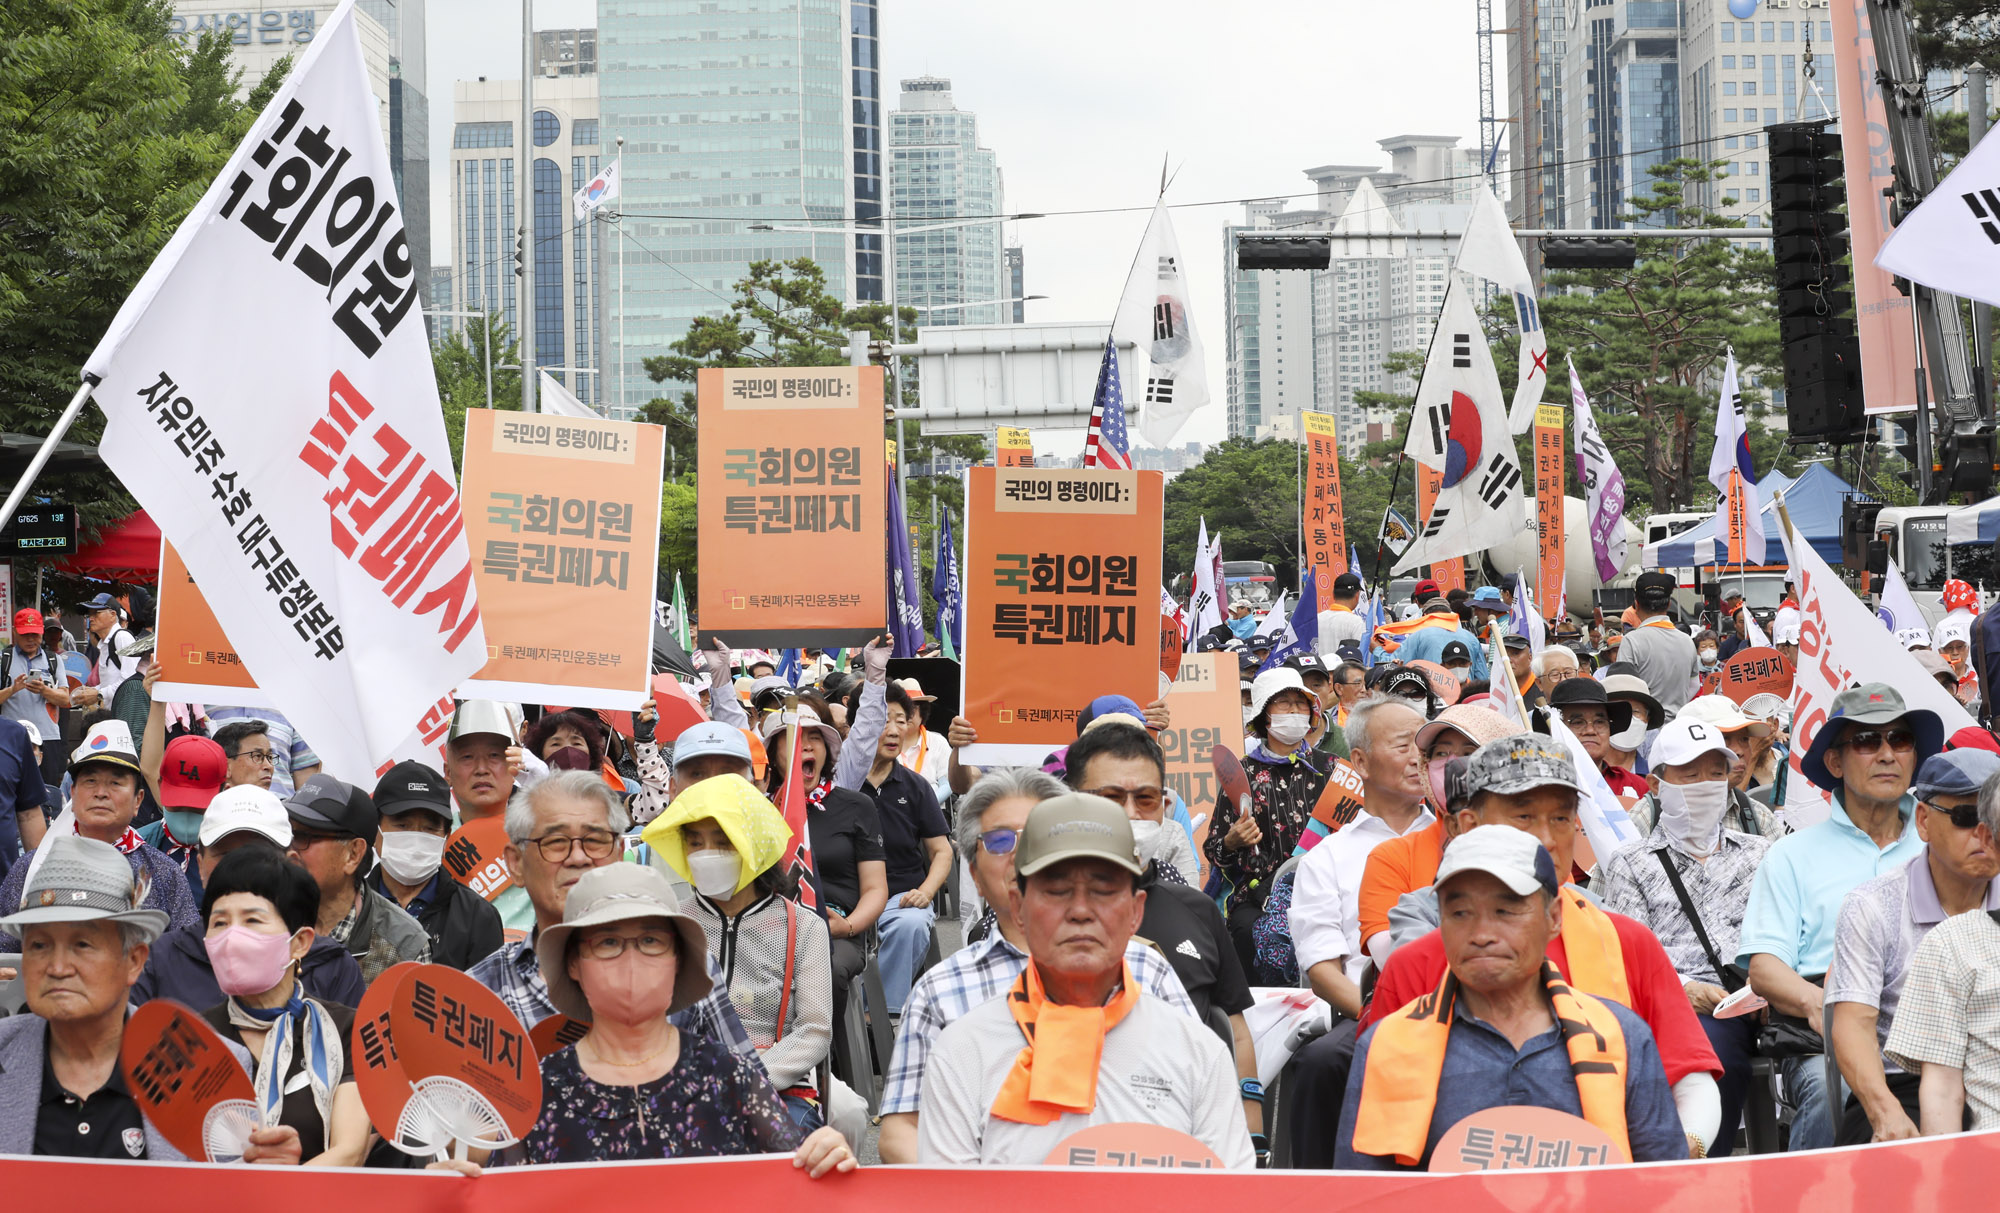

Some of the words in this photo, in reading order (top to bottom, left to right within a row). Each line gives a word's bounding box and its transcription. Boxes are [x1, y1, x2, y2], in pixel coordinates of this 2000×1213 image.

[732, 379, 778, 399] 국민의
[502, 422, 550, 446] 국민의
[723, 447, 861, 487] 국회의원
[1004, 479, 1052, 501] 국민의
[1312, 440, 1329, 568] 특권폐지동의
[1325, 442, 1343, 557] 특권폐지반대
[1538, 433, 1549, 561] 특권폐지동의
[1551, 434, 1560, 550] 특권폐지반대
[18, 514, 39, 523] G7625
[136, 371, 226, 476] 자유민주
[211, 471, 253, 527] 수호
[236, 513, 345, 661] 대구투쟁본부
[487, 491, 633, 543] 국회의원
[723, 493, 861, 534] 특권폐지
[482, 540, 630, 590] 특권폐지
[994, 553, 1137, 596] 국회의원
[1549, 554, 1559, 609] OUT
[749, 593, 861, 608] 특권폐지국민운동본부
[992, 603, 1136, 646] 특권폐지
[502, 645, 622, 667] 특권폐지국민운동본부
[1729, 655, 1784, 683] 특권폐지
[1689, 725, 1706, 741] C
[179, 760, 200, 780] LA
[411, 979, 523, 1081] 특권폐지
